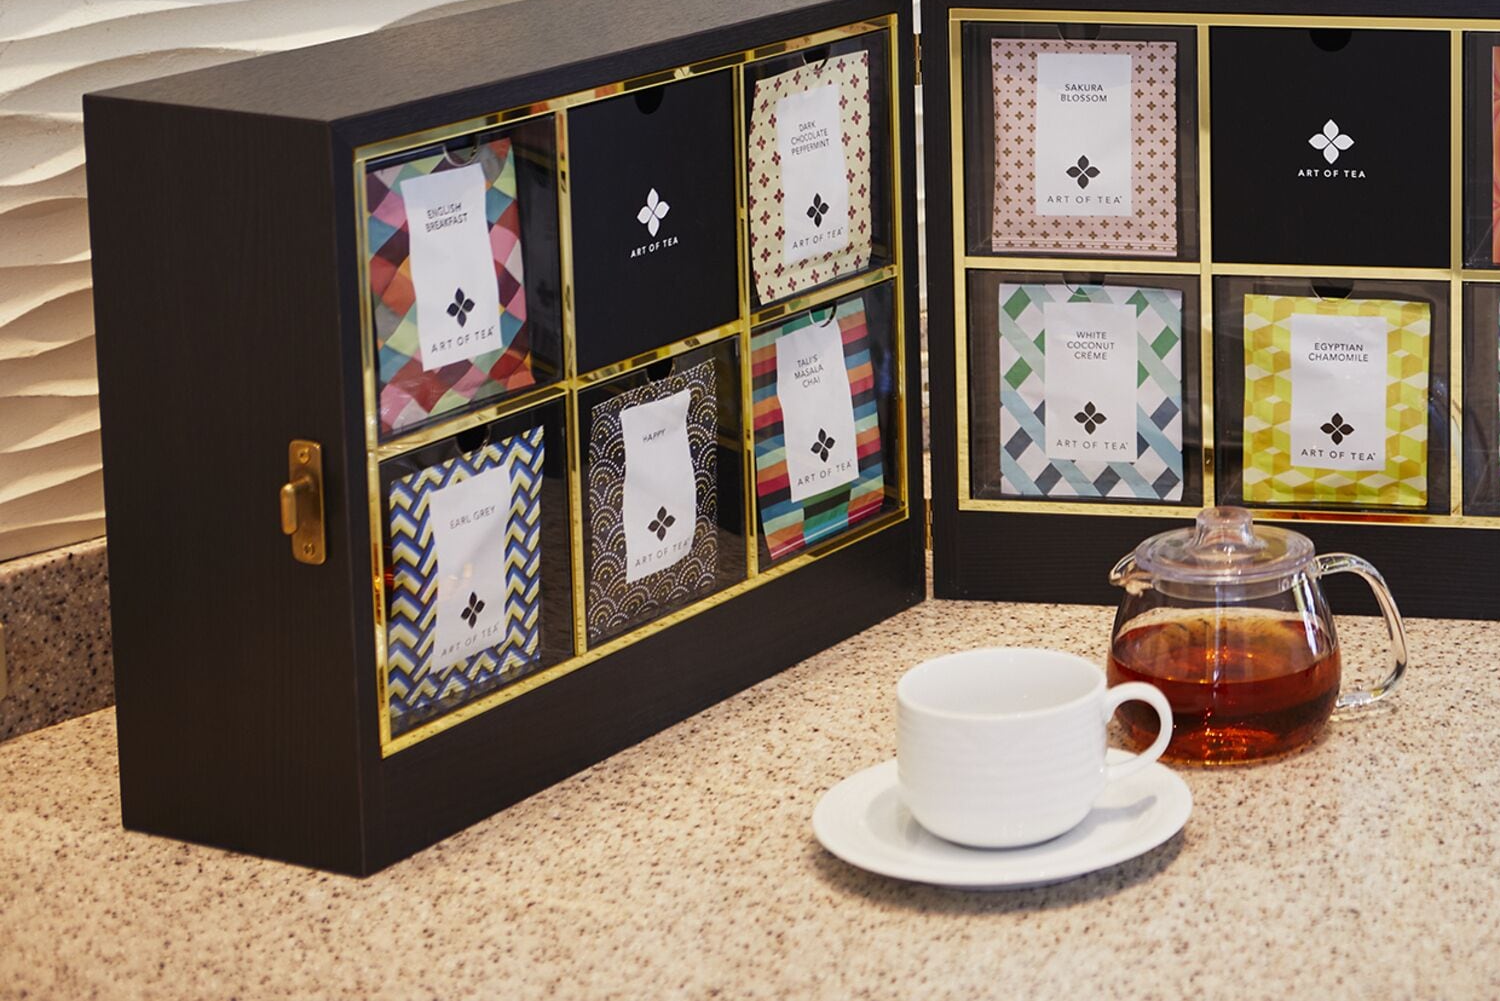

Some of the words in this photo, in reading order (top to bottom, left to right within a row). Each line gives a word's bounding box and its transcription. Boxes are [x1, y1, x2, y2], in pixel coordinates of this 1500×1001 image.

[1064, 83, 1104, 92] SAKURA
[1060, 93, 1108, 102] BLOSSOM
[1297, 169, 1320, 177] ART
[1323, 169, 1340, 178] OF
[1343, 169, 1366, 179] TEA
[1047, 195, 1070, 204] ART
[1075, 195, 1091, 205] OF
[1097, 195, 1121, 205] TEA
[791, 237, 810, 250] ART
[812, 234, 825, 245] OF
[630, 245, 647, 259] ART
[648, 241, 661, 253] OF
[662, 236, 679, 248] TEA
[1075, 331, 1108, 340] WHITE
[431, 339, 453, 354] ART
[456, 334, 470, 346] OF
[1066, 340, 1115, 350] COCONUT
[1314, 342, 1364, 351] EGYPTIAN
[1308, 352, 1369, 362] CHAMOMILE
[1056, 439, 1077, 448] ART
[1082, 440, 1098, 449] OF
[1104, 441, 1127, 450] TEA
[1301, 448, 1324, 457] ART
[1329, 450, 1345, 459] OF
[1350, 452, 1374, 461] TEA
[797, 473, 815, 486] ART
[819, 467, 832, 479] OF
